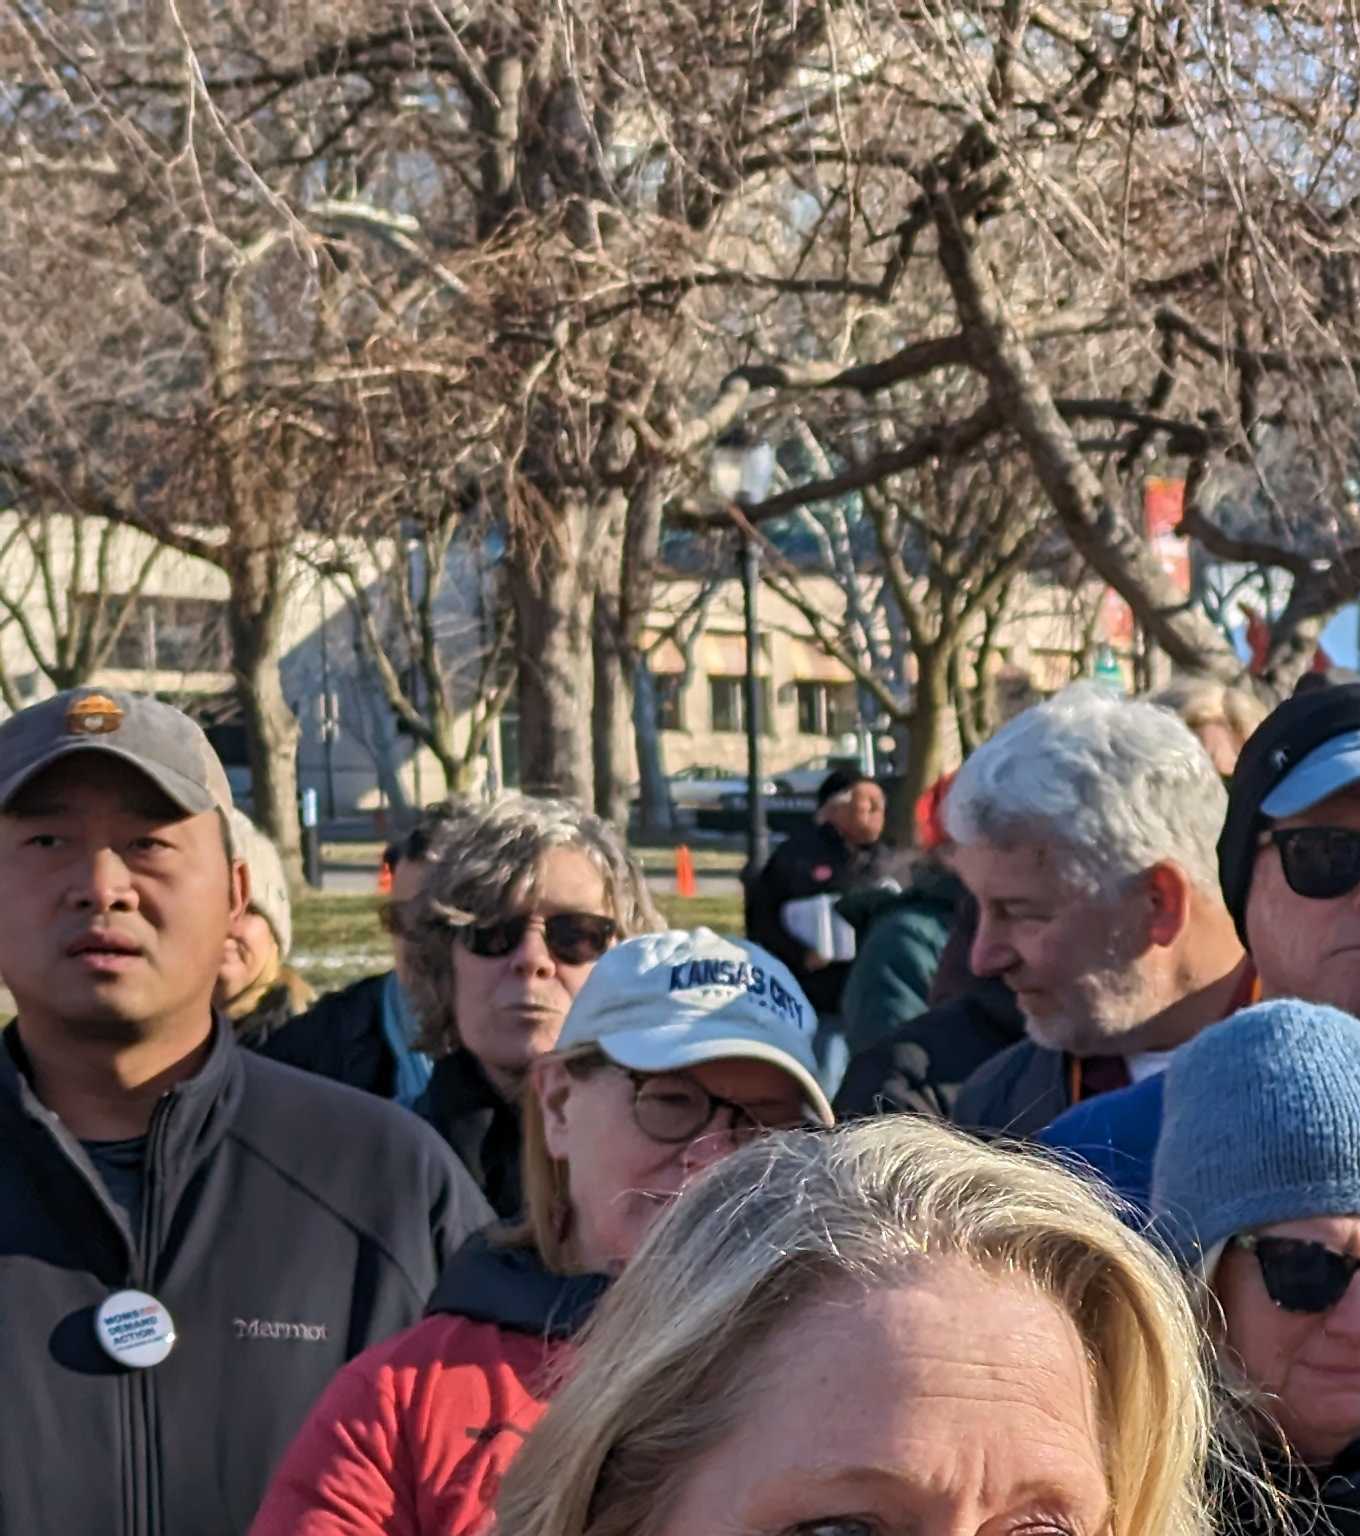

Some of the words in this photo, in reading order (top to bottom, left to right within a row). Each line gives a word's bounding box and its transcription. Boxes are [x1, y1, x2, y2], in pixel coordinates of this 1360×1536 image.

[669, 957, 765, 995] KANSAS
[107, 1315, 158, 1336] DEMAND
[113, 1327, 156, 1346] ACTION
[232, 1317, 328, 1341] Marmot
